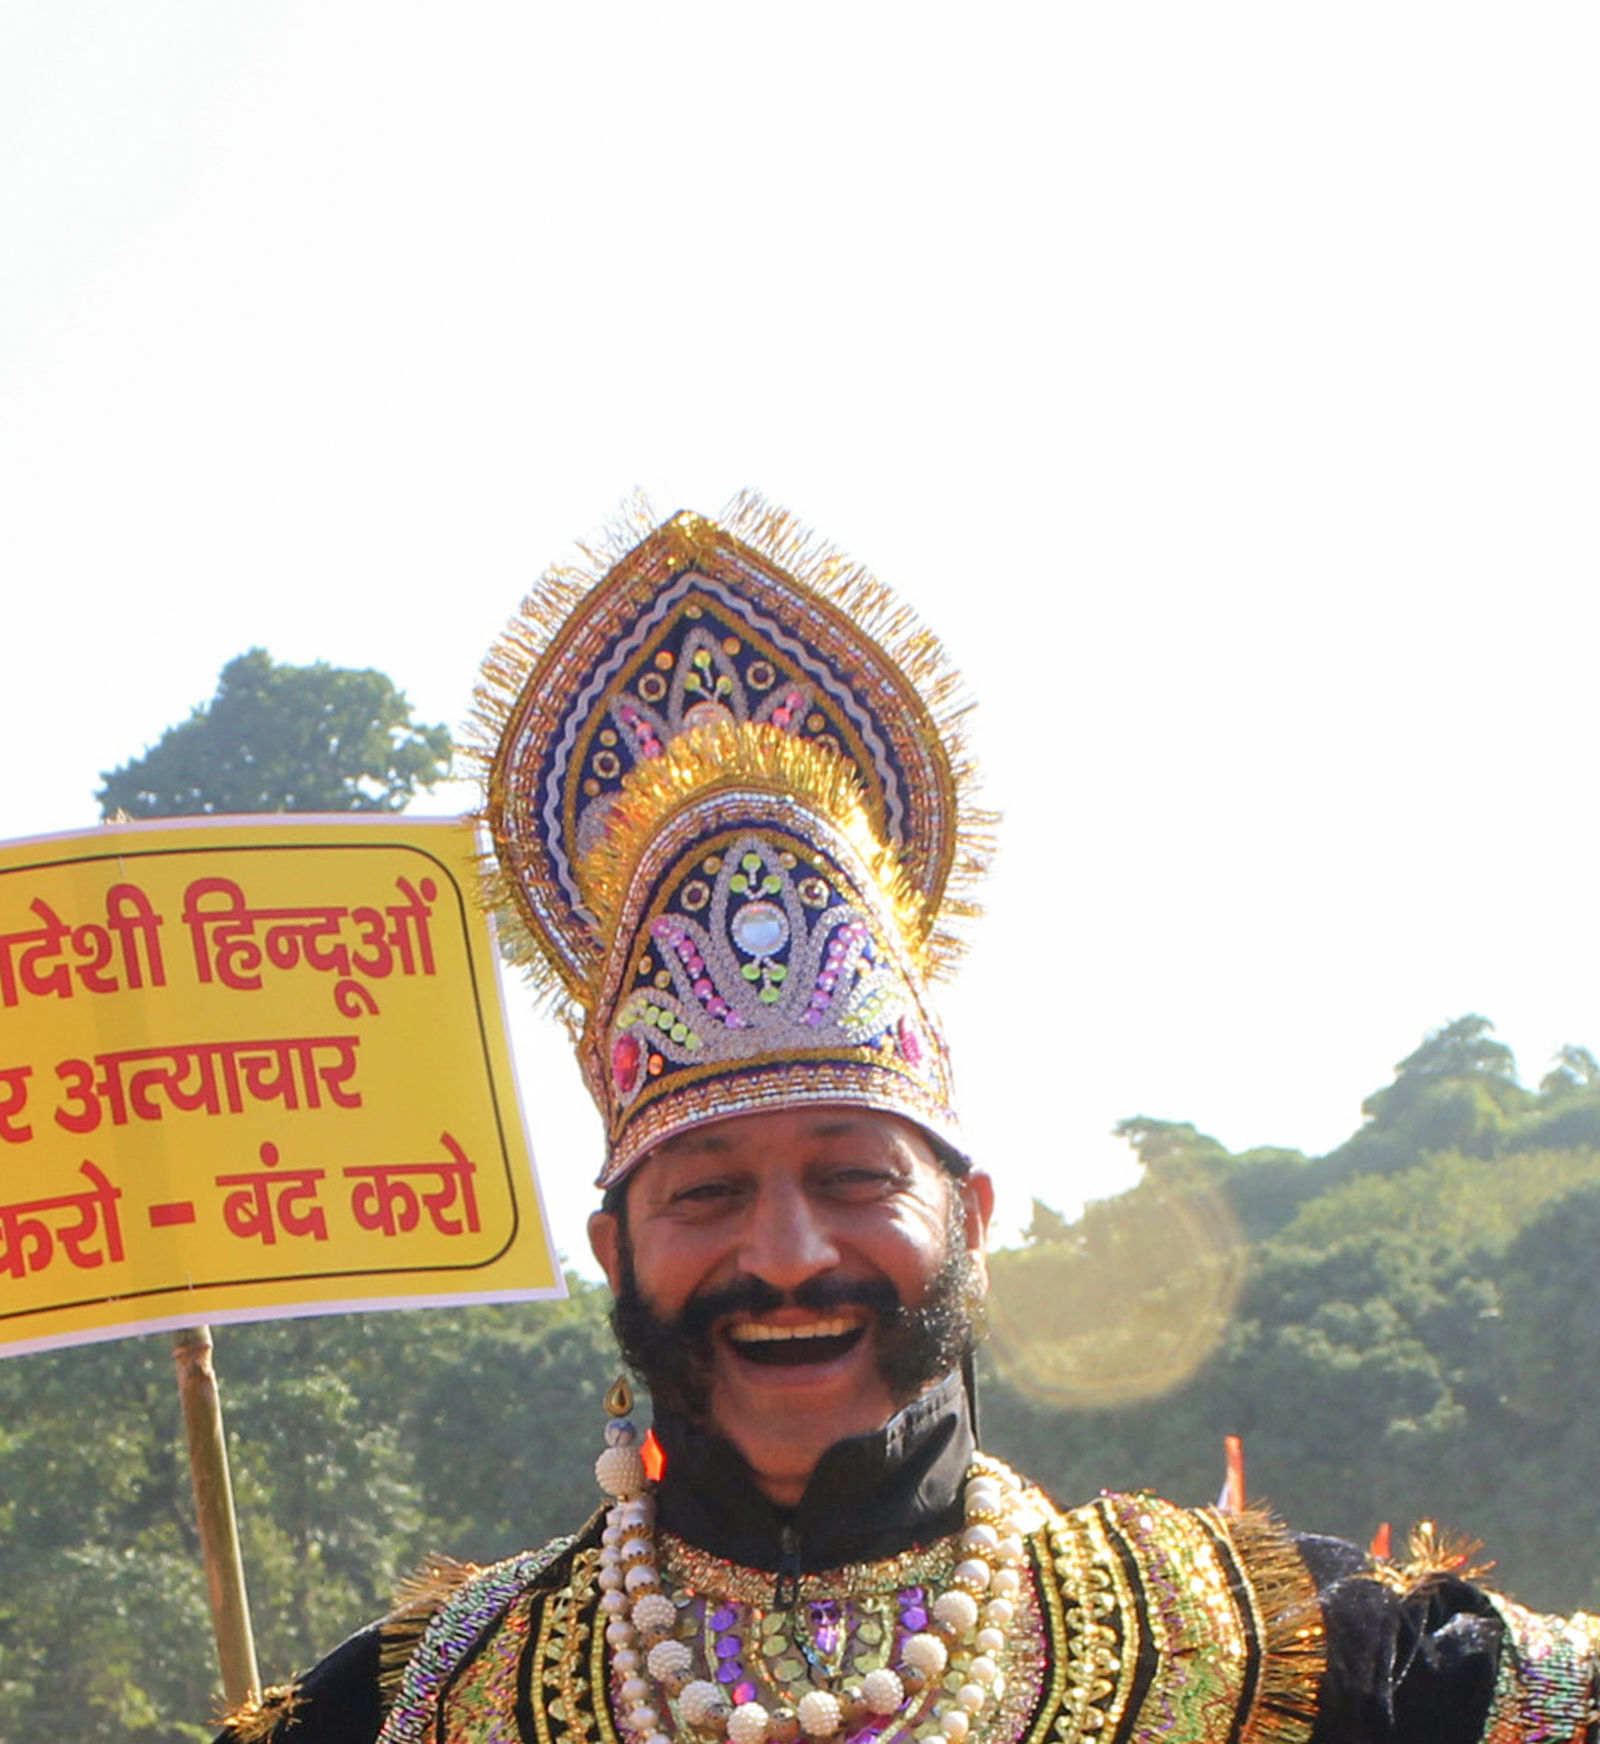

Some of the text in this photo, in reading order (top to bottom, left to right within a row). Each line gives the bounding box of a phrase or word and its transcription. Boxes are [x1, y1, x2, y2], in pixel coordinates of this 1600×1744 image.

[185, 880, 435, 1016] हिन्दूओं
[56, 1038, 360, 1133] अत्याचार
[218, 1144, 326, 1244] बंद
[347, 1136, 478, 1235] करो
